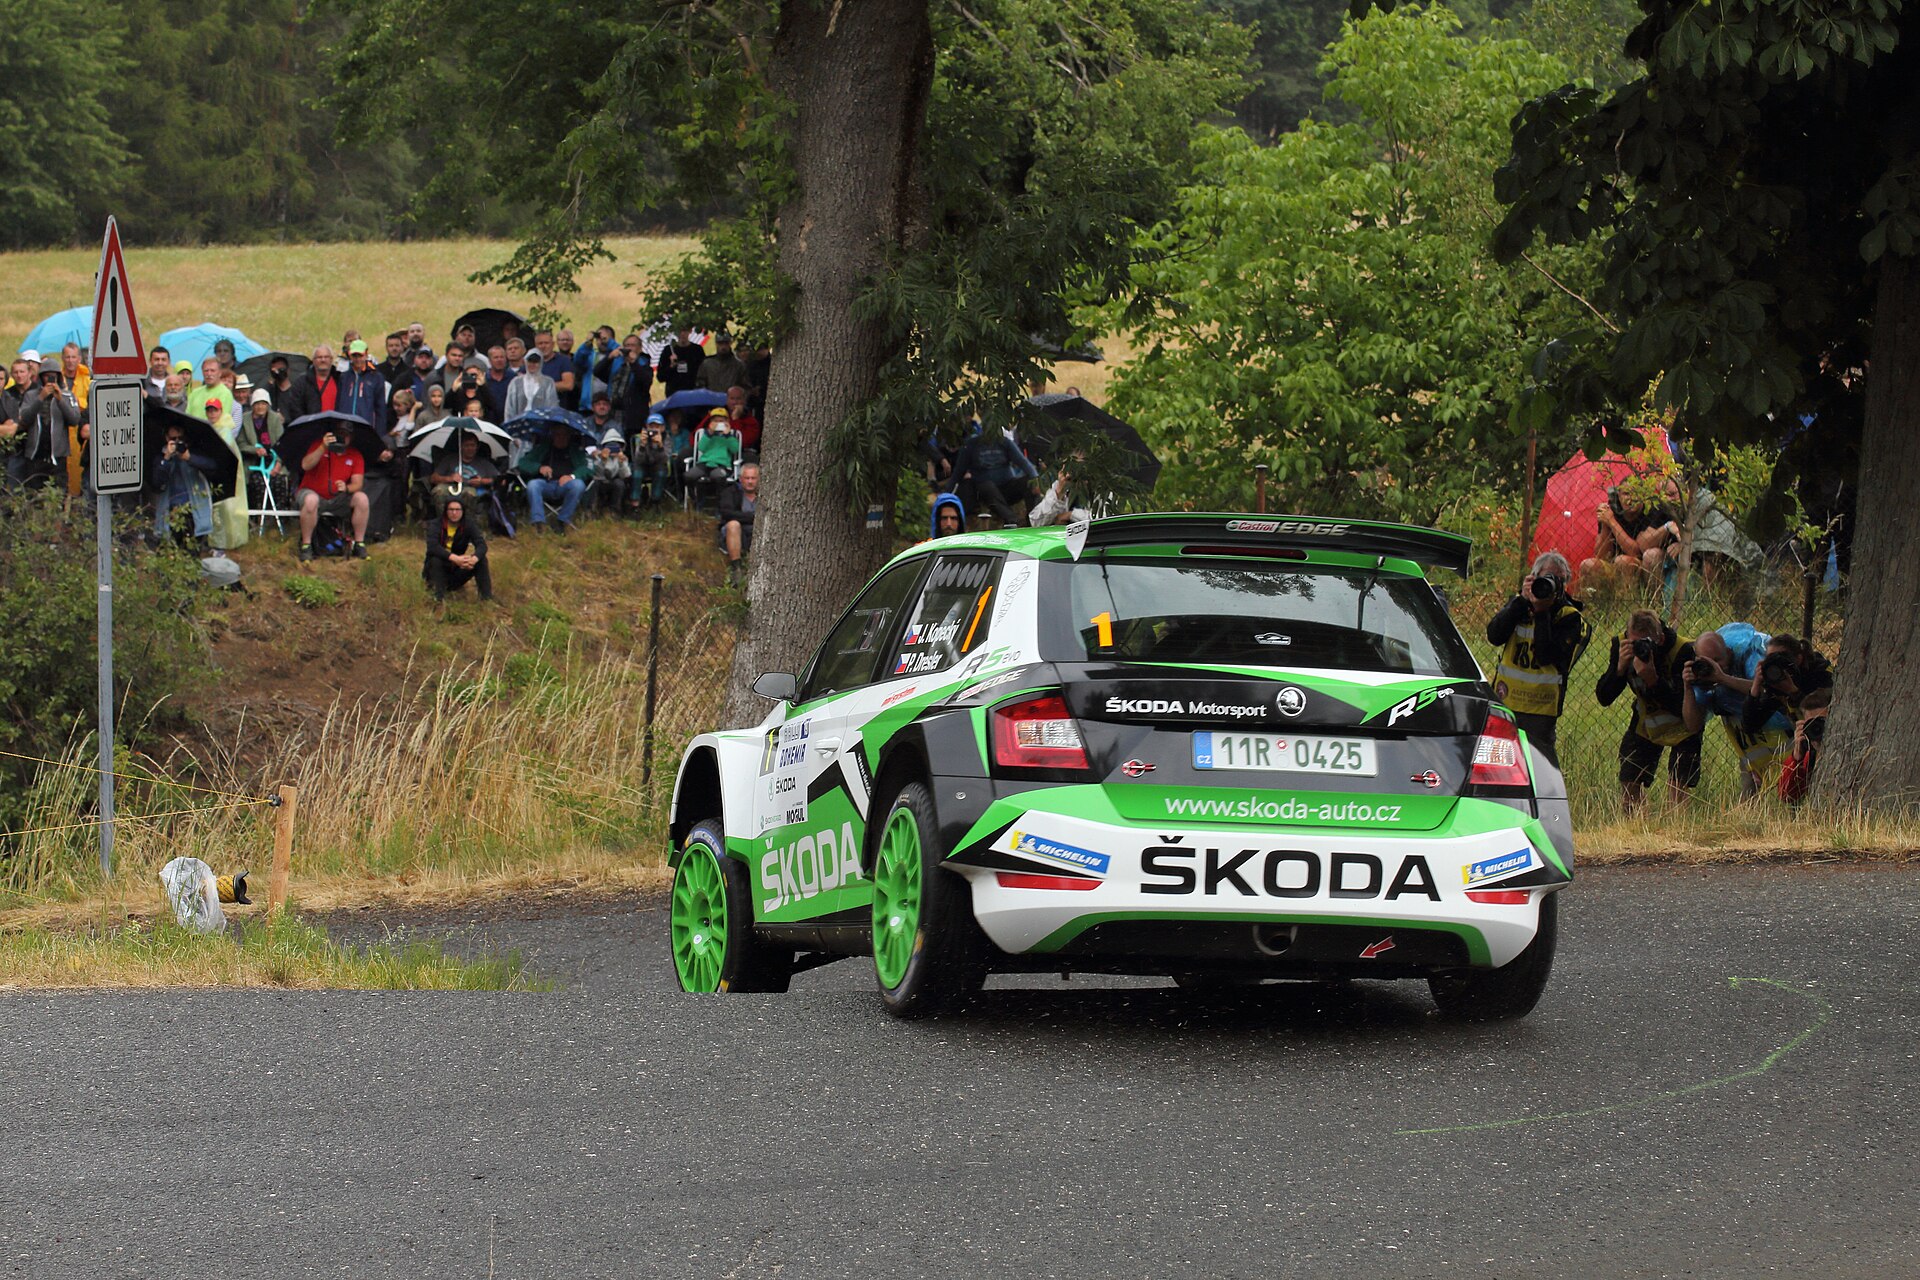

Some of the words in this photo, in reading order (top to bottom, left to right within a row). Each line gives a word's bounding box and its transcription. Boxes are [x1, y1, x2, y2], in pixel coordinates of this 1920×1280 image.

[106, 400, 131, 418] SILNICE
[102, 429, 110, 446] SE
[113, 429, 118, 445] V
[120, 424, 136, 445] ZIMĚ
[101, 453, 136, 474] NEUDRŽUJE
[1237, 521, 1275, 532] Castrol
[1276, 522, 1351, 536] EDGE
[961, 585, 993, 653] 1
[1090, 611, 1113, 647] 1
[925, 618, 961, 647] Kopecký
[912, 650, 944, 672] Dresler
[1105, 696, 1185, 713] ŠKODA
[1189, 701, 1267, 719] Motorsport
[1387, 687, 1438, 727] R5
[779, 743, 807, 768] BOHEMIA
[1197, 754, 1212, 764] CZ
[1221, 736, 1271, 767] 11R
[1295, 739, 1363, 770] 0425
[775, 776, 796, 795] ŠKODA
[786, 807, 805, 824] MOGUL
[1164, 796, 1402, 823] www.skoda-auto.cz
[761, 821, 863, 913] ŠKODA
[1036, 844, 1103, 867] MICHELIN
[1484, 854, 1527, 874] MICHELIN
[1140, 835, 1442, 902] ŠKODA
